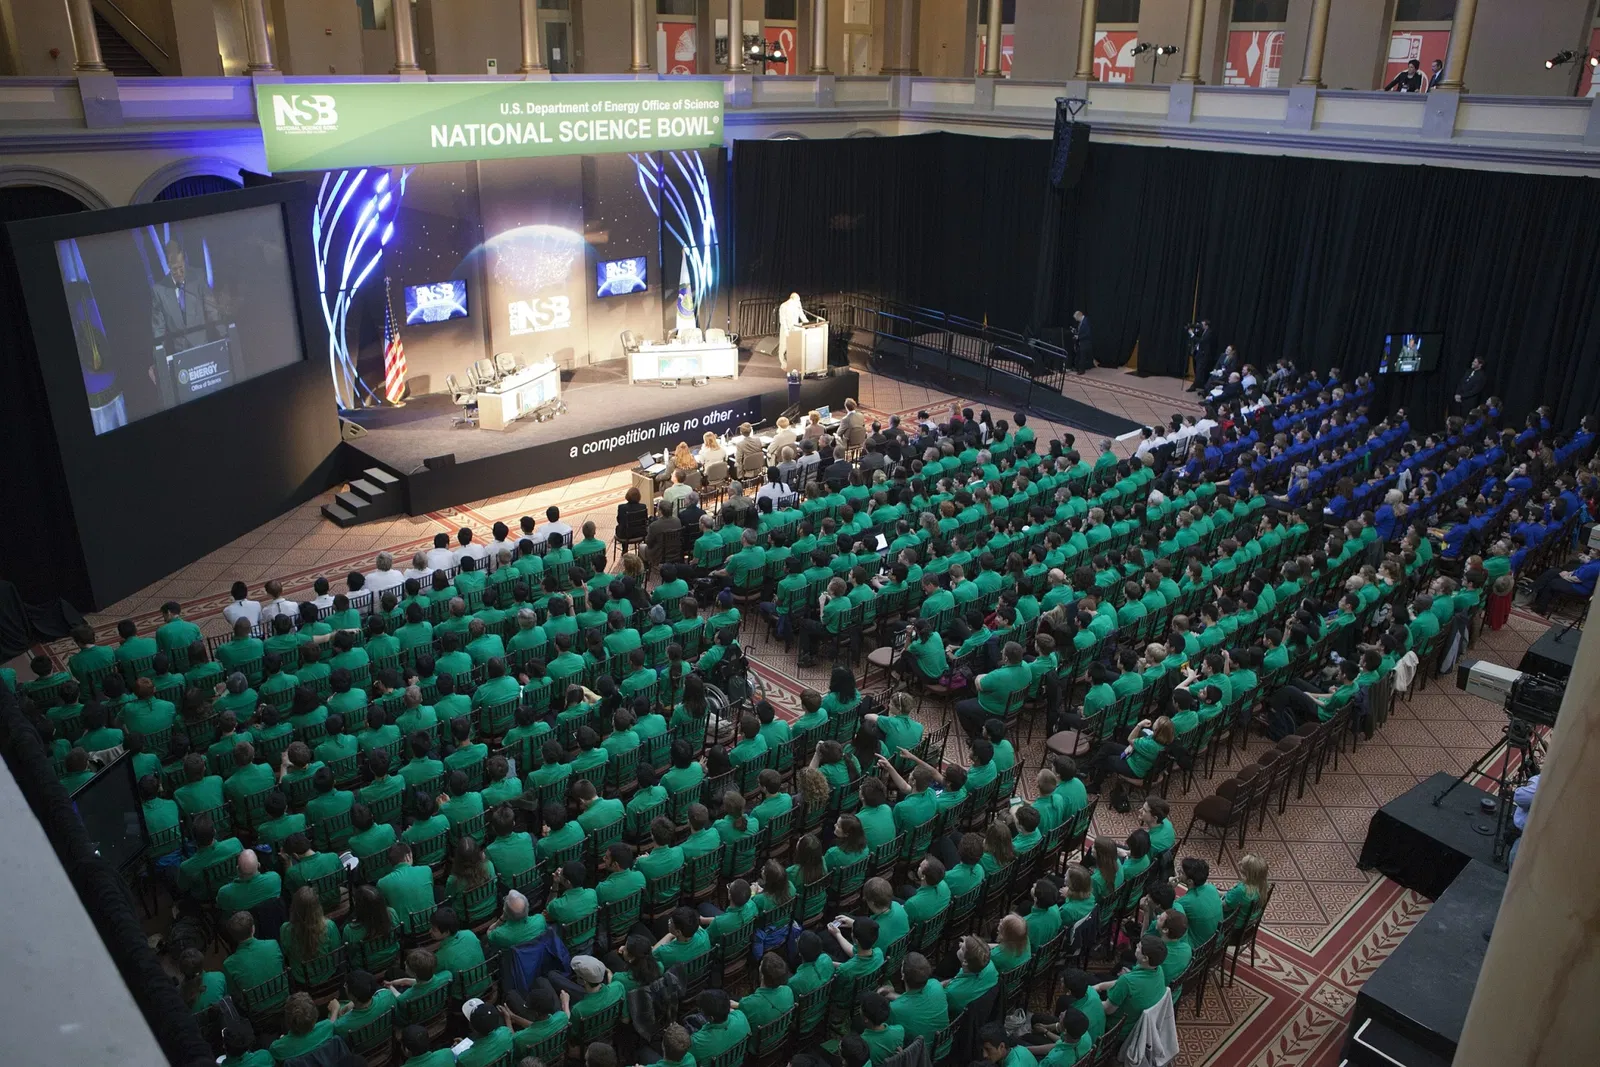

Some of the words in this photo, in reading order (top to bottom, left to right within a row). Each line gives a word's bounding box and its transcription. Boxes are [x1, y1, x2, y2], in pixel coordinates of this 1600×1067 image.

[272, 95, 338, 126] NSB
[500, 102, 524, 115] U.S.
[526, 101, 589, 116] Department
[591, 101, 602, 112] of
[604, 100, 640, 114] Energy
[641, 99, 670, 111] Office
[672, 98, 683, 110] of
[684, 98, 719, 109] Science
[430, 121, 553, 148] NATIONAL
[558, 118, 652, 142] SCIENCE
[516, 295, 571, 329] NSB
[188, 363, 218, 381] ENERGY
[569, 445, 578, 458] a
[582, 427, 656, 455] competition
[659, 421, 680, 437] like
[683, 418, 699, 431] no
[702, 409, 733, 426] other
